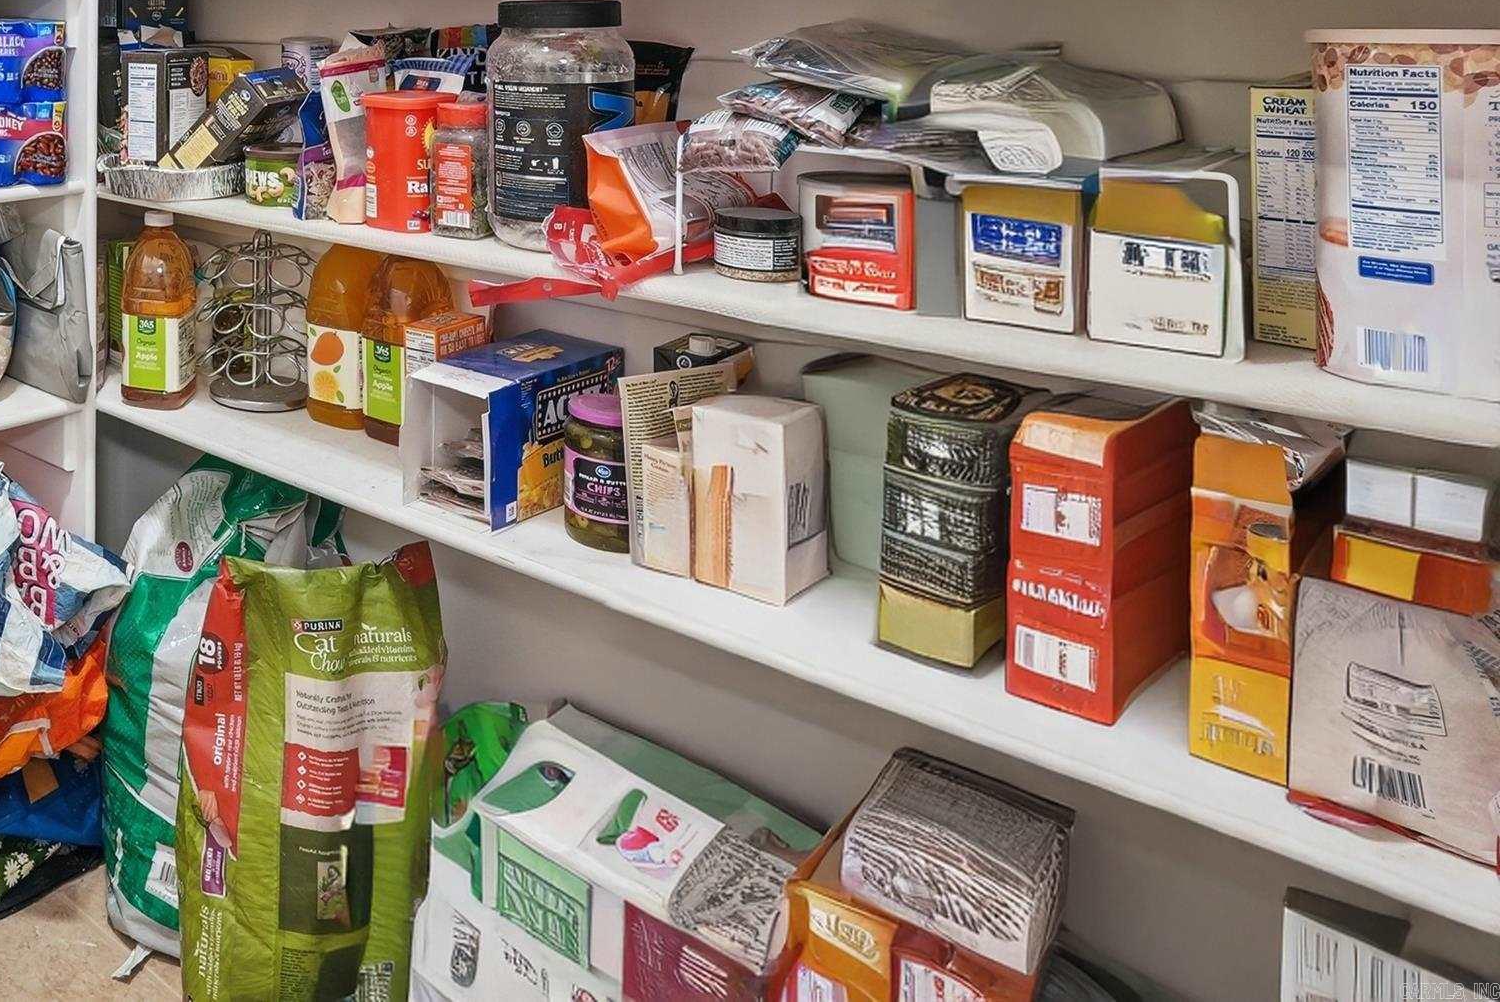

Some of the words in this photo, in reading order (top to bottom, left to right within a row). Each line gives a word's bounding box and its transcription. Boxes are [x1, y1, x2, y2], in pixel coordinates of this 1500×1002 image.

[1349, 68, 1399, 79] Nutrition
[1402, 68, 1438, 79] Facts
[1262, 96, 1307, 108] CREAM
[1349, 99, 1389, 110] Calories
[1410, 99, 1437, 111] 150
[1263, 104, 1307, 116] WHEAT
[1293, 118, 1315, 127] Fact
[1286, 149, 1300, 158] 120
[135, 351, 158, 362] Apple
[373, 379, 393, 390] Apple
[543, 400, 568, 427] AC
[586, 482, 620, 496] CHIPS
[304, 620, 342, 631] PURINA
[354, 627, 412, 645] naturals
[294, 633, 338, 654] Cat
[199, 637, 216, 665] 18
[214, 713, 225, 765] original
